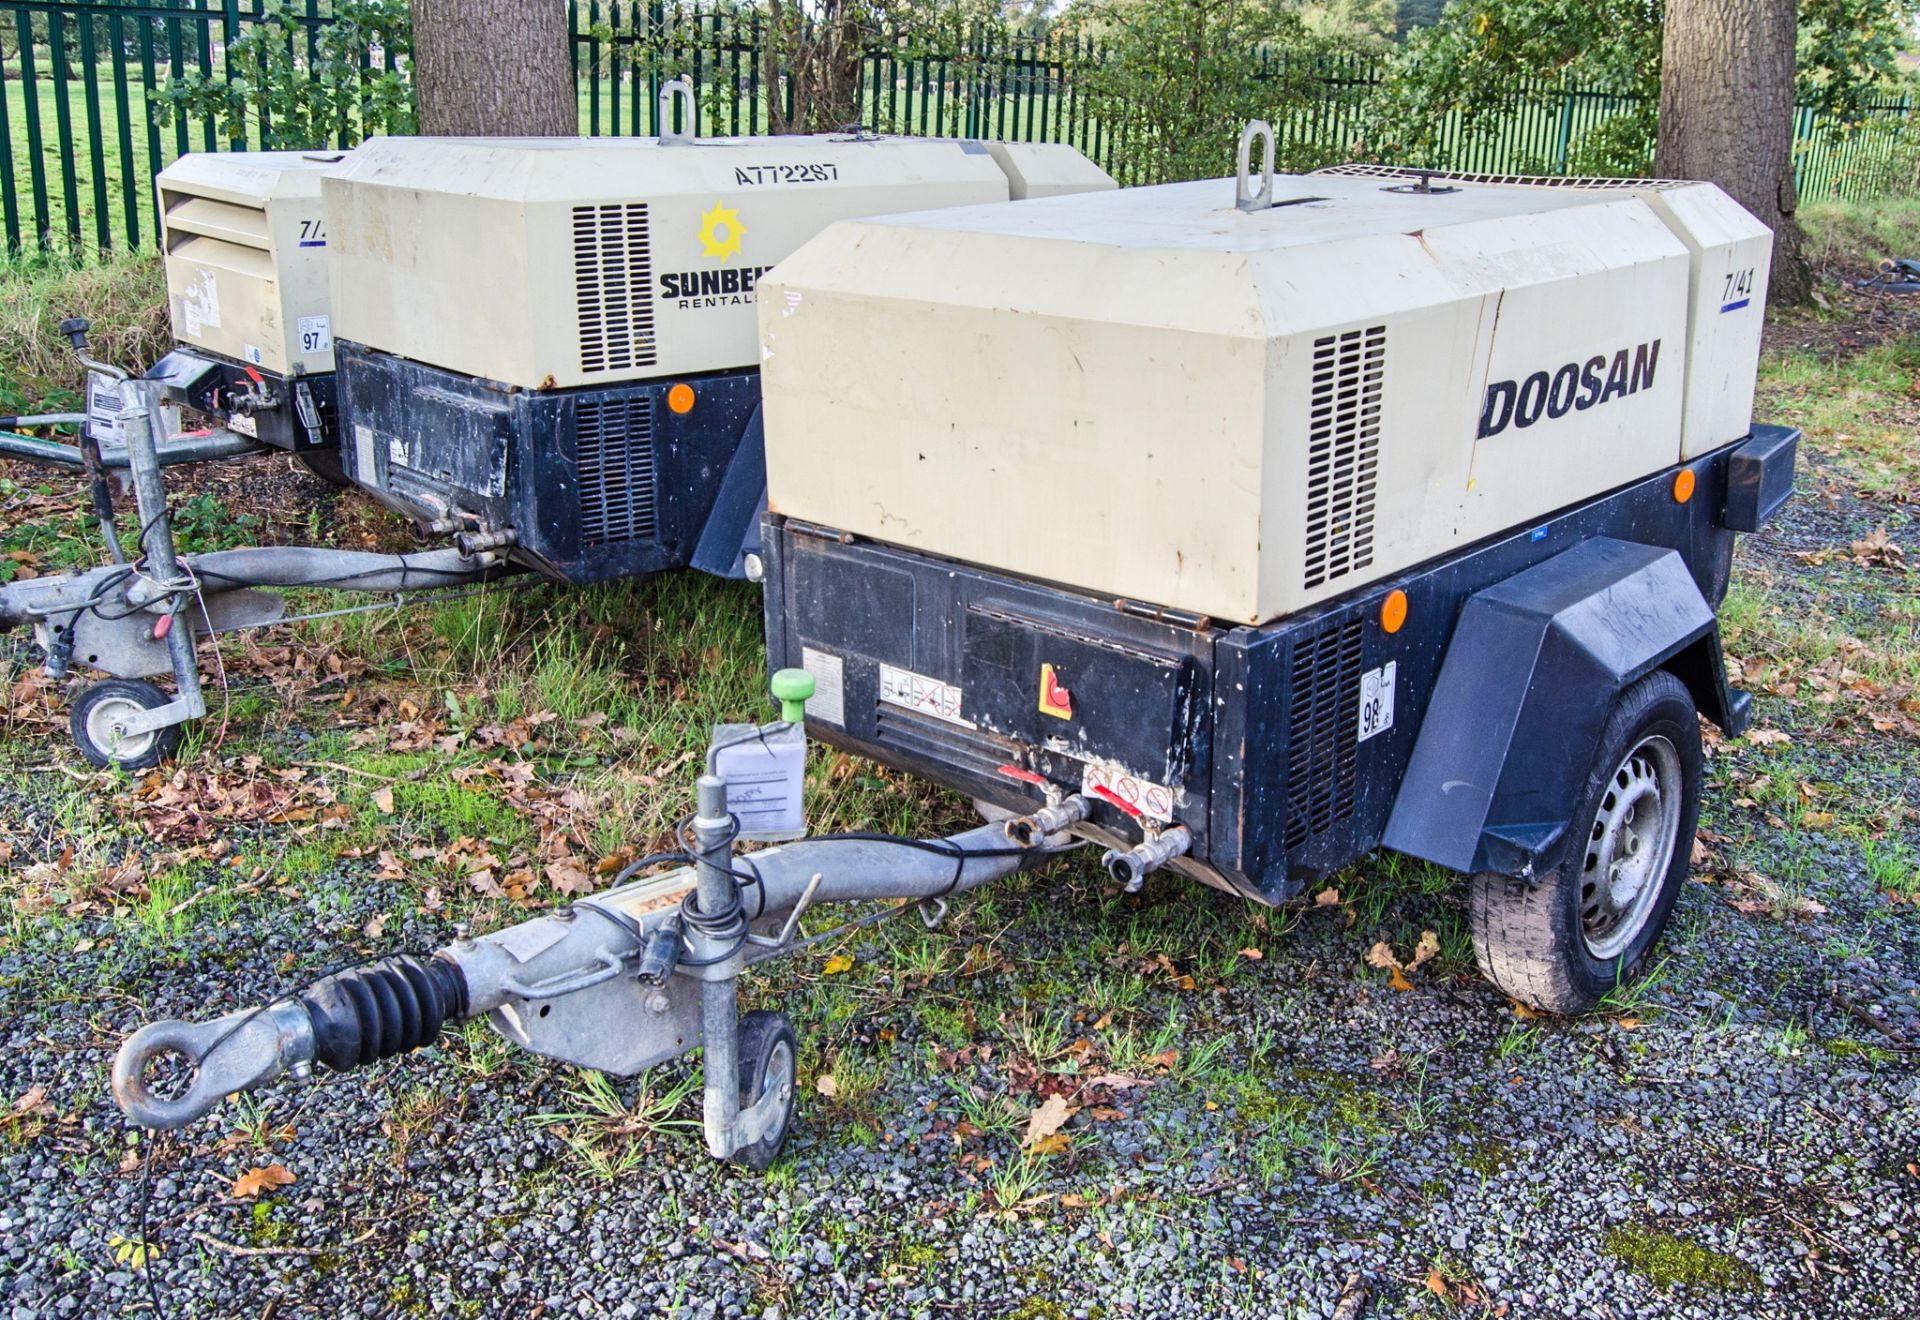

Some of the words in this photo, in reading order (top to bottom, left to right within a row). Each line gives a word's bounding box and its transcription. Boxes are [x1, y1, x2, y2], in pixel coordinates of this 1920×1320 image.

[660, 265, 775, 299] SUNBE
[1722, 267, 1754, 302] 7/41
[679, 294, 758, 310] RENTAL
[303, 332, 320, 350] 97
[1477, 338, 1662, 440] DOOSAN
